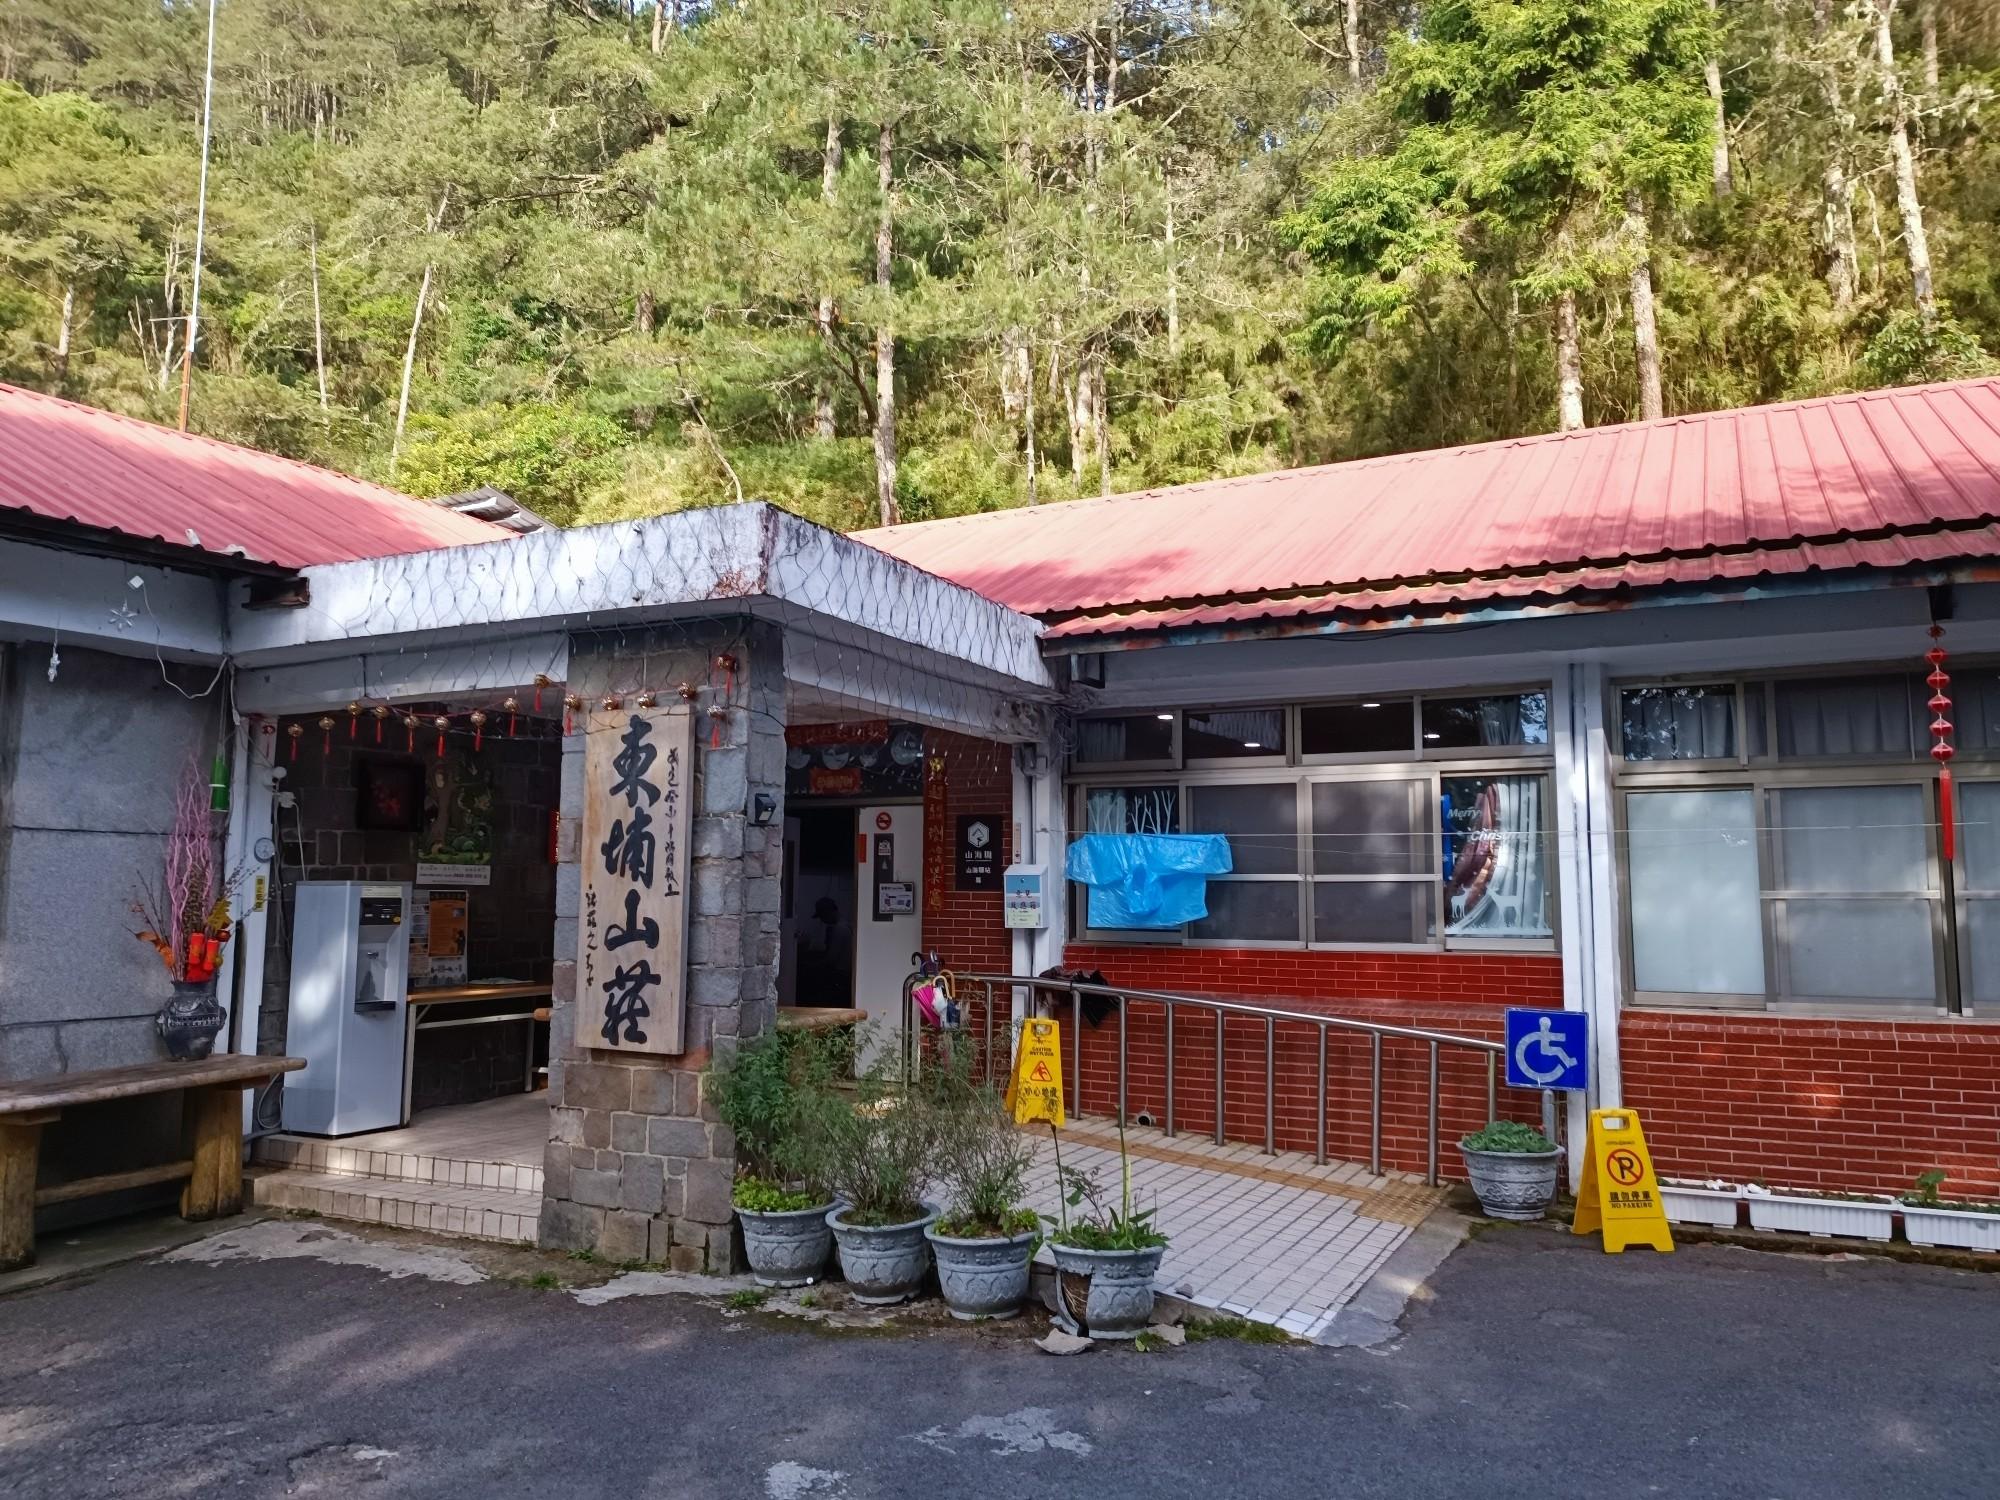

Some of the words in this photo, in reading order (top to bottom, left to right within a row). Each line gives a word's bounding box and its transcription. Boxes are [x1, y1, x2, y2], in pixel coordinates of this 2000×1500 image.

[1447, 808, 1478, 820] Merry
[602, 715, 661, 1046] 東埔山莊
[1610, 1190, 1651, 1201] 請勿停車
